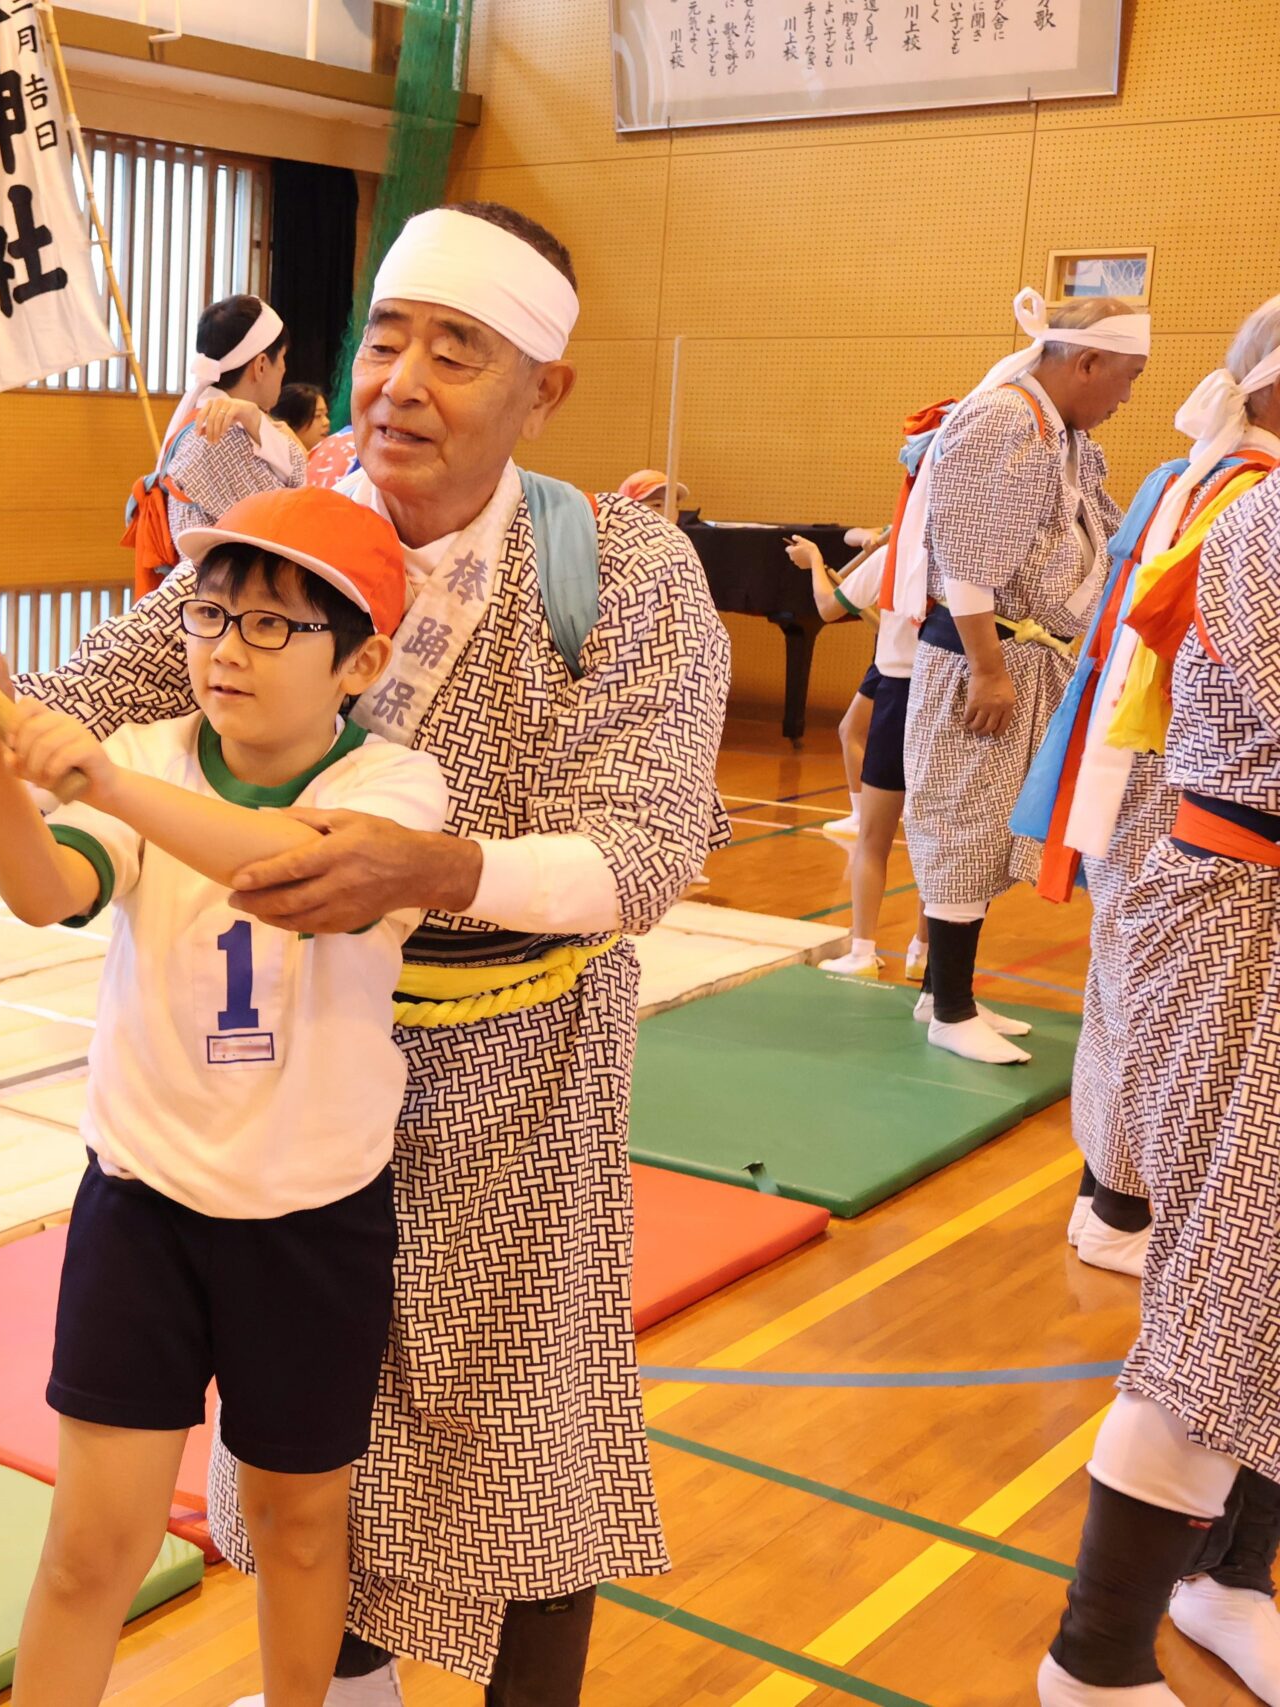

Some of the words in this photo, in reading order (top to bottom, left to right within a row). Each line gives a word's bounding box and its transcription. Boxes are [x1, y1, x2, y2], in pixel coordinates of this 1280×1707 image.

[670, 28, 685, 69] 川上校
[706, 13, 720, 77] よい子ども
[783, 16, 799, 61] 川上校
[823, 1, 837, 68] よい子ども
[902, 4, 922, 51] 川上校
[373, 550, 489, 727] 棒踊保
[217, 920, 259, 1031] 1
